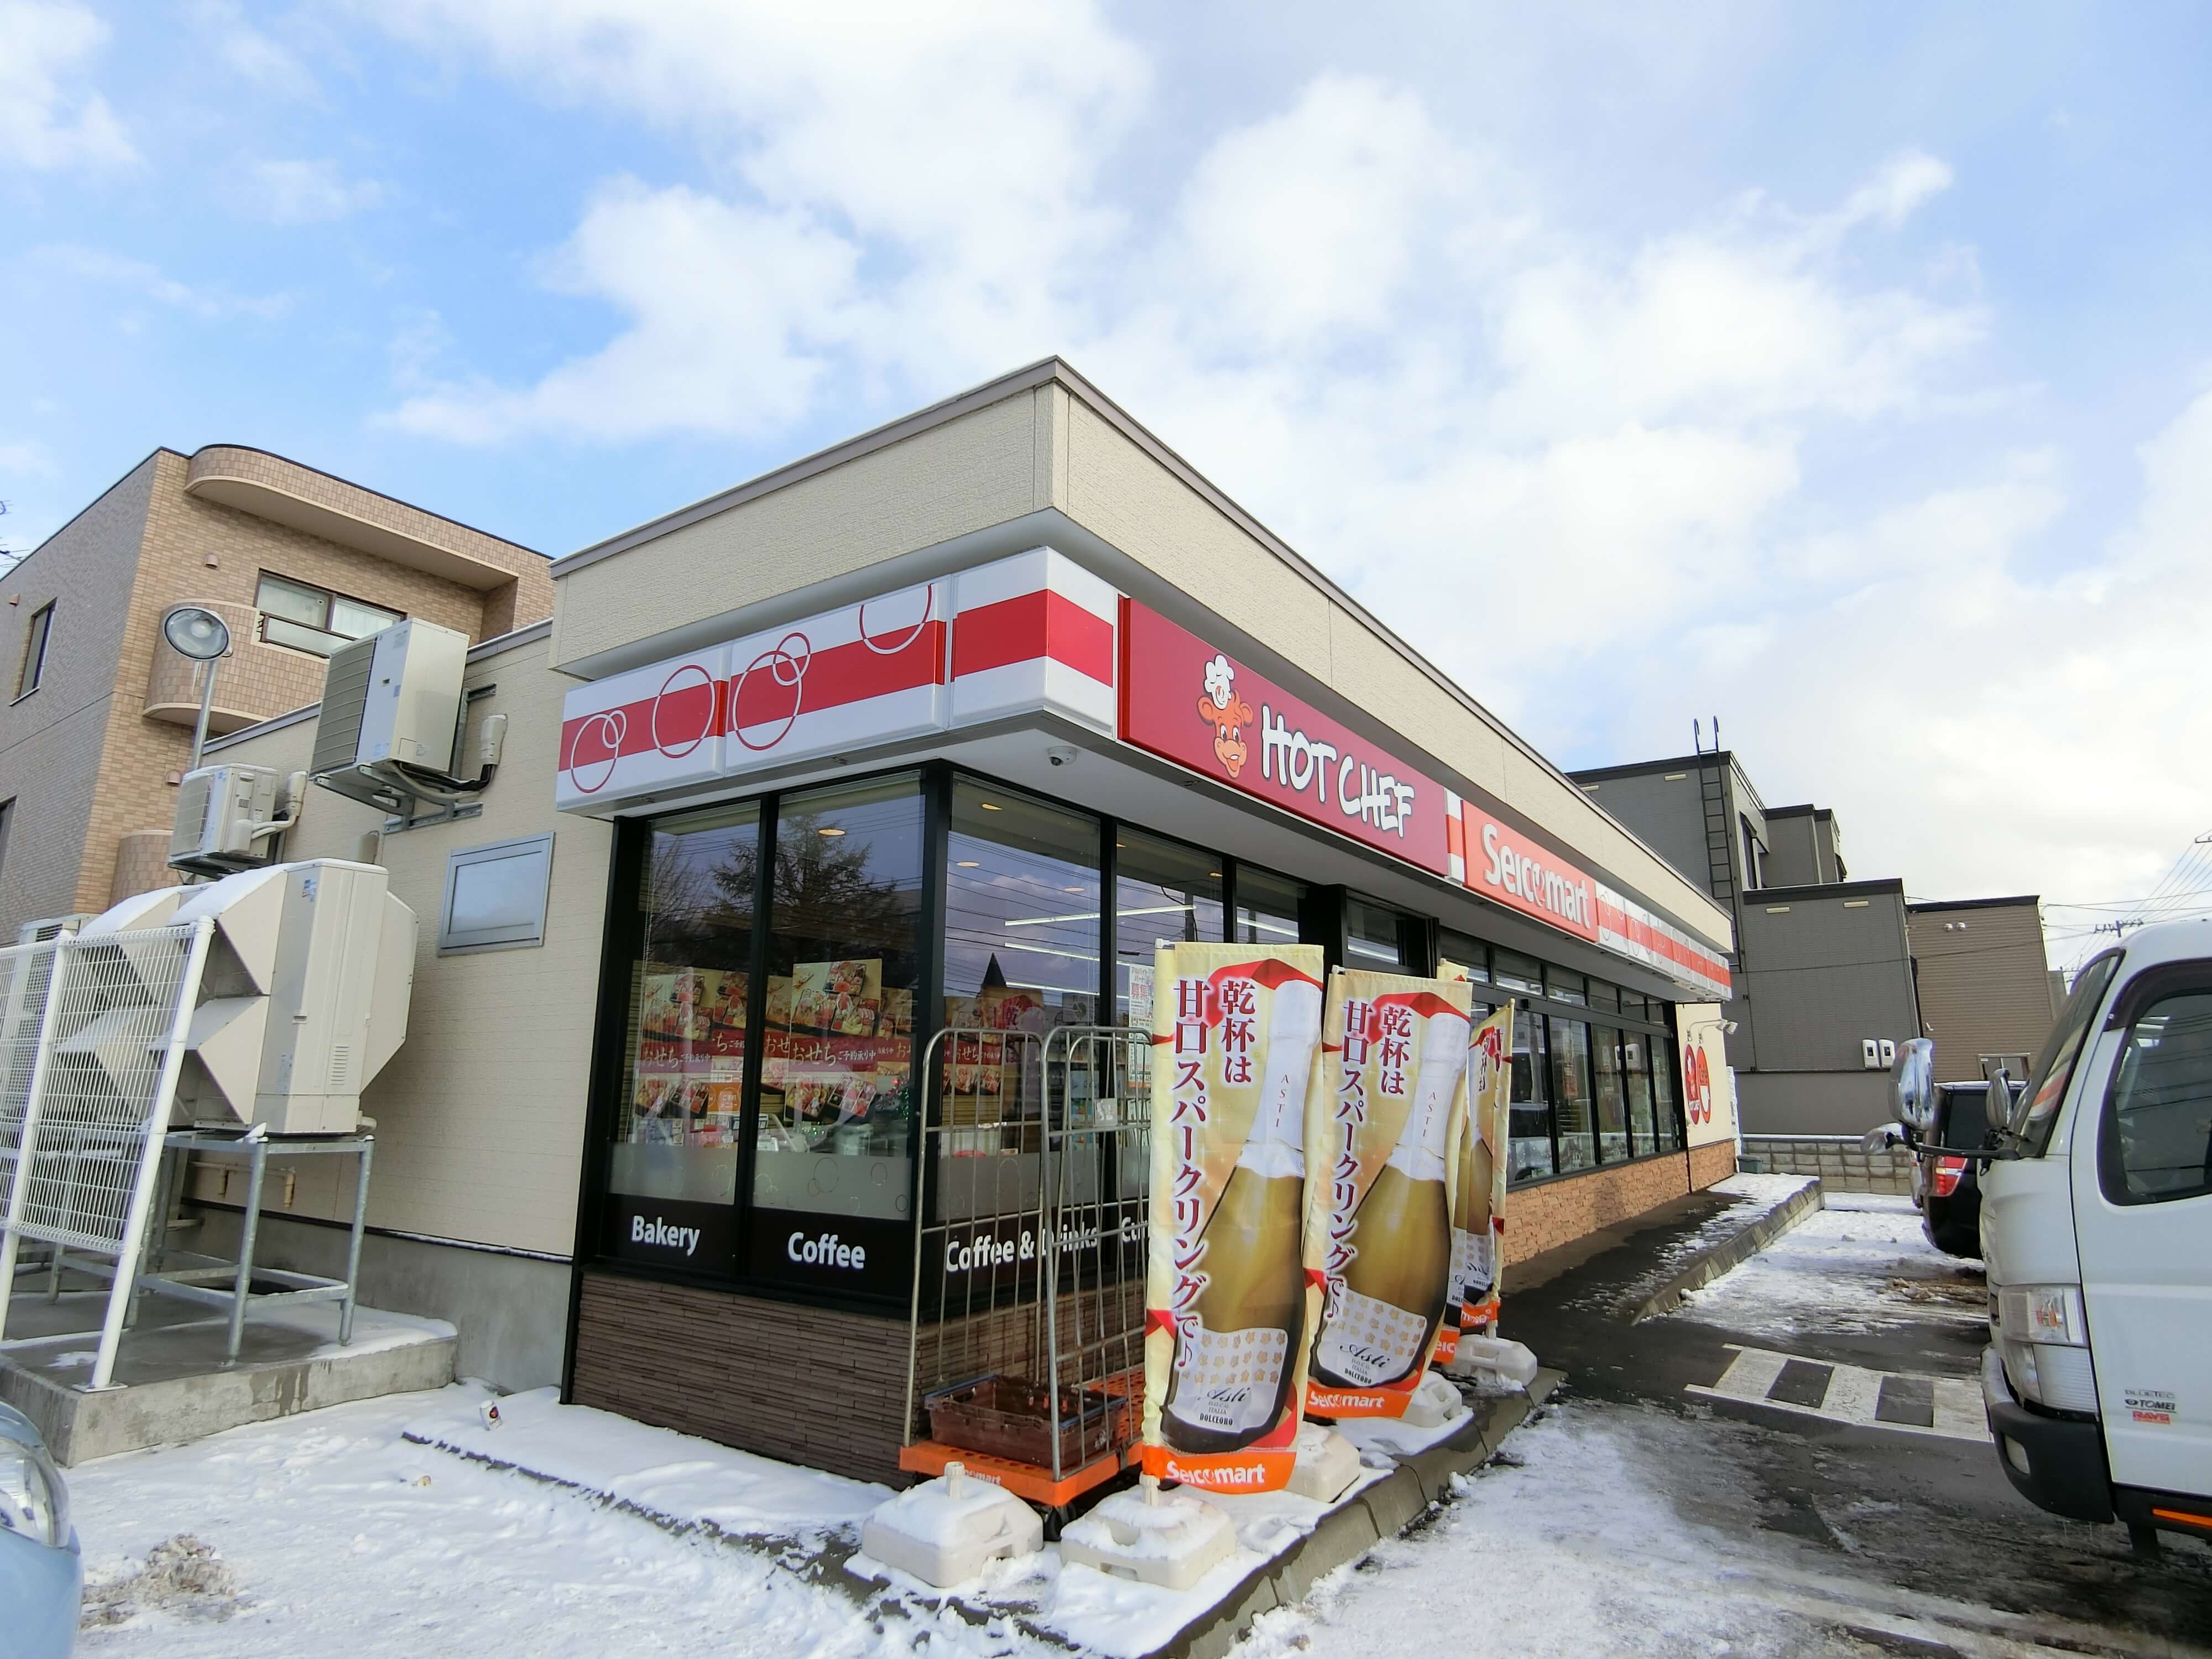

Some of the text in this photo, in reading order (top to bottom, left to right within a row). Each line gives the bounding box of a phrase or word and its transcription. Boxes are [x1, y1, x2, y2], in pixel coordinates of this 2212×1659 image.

[1261, 705, 1415, 838] HOT CHEF
[1482, 823, 1590, 929] Seicomart
[1131, 983, 1149, 1000] 募集
[1221, 980, 1256, 1083] 乾杯は
[793, 1041, 837, 1066] おせち
[1380, 1005, 1413, 1095] 乾杯は
[632, 1215, 701, 1256] Bakery
[787, 1232, 865, 1269] Coffee
[946, 1234, 1014, 1272] Coffee
[1019, 1230, 1035, 1260] &
[1339, 1344, 1390, 1368] Asti
[1208, 1407, 1227, 1415] ITALIA
[1308, 1390, 1385, 1408] Seicomart
[2139, 1400, 2176, 1410] TOMEI
[1199, 1412, 1233, 1426] DOLCEORO
[1165, 1460, 1266, 1485] Seicomart
